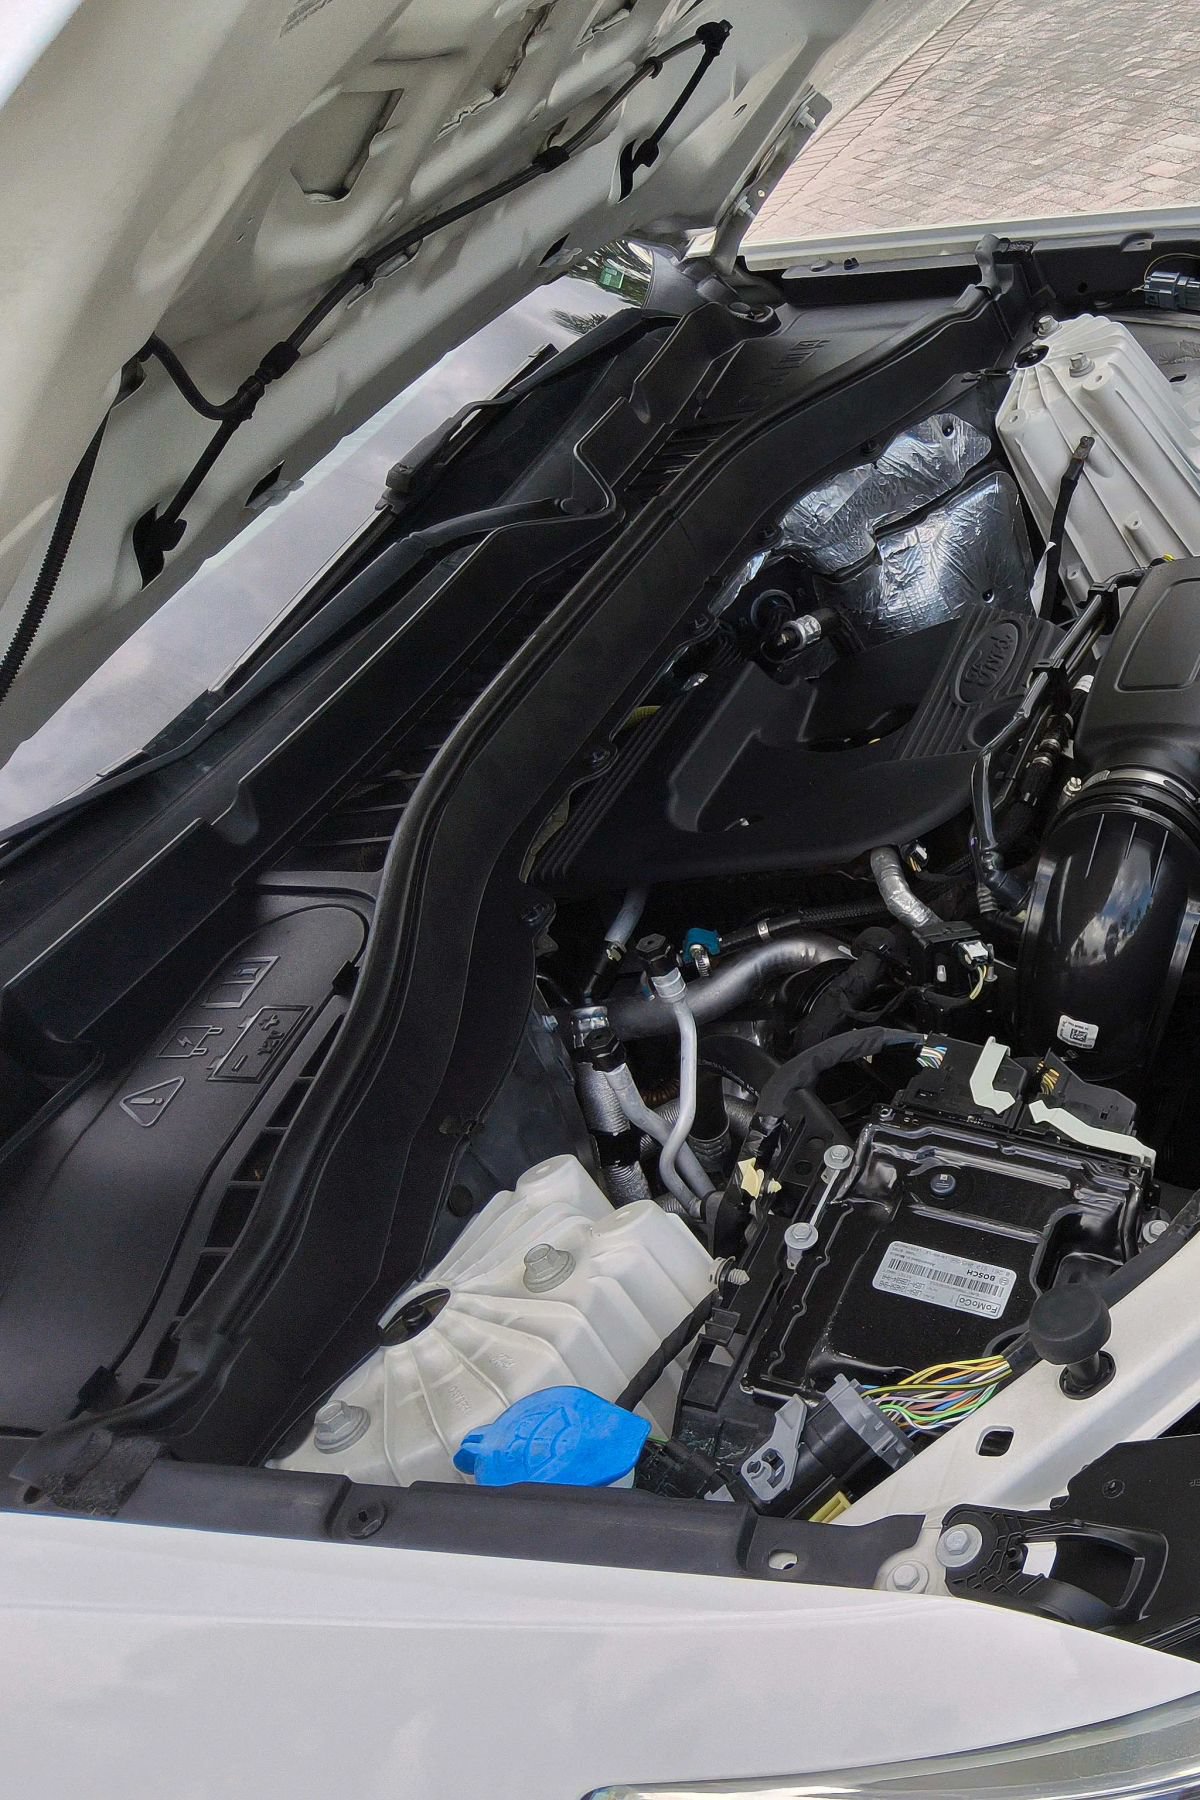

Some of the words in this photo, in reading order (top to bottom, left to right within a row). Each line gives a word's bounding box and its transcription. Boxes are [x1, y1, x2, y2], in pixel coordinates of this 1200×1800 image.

[964, 633, 1013, 687] Ford
[966, 1269, 996, 1281] BOSCH
[959, 1297, 998, 1314] FoMoCo
